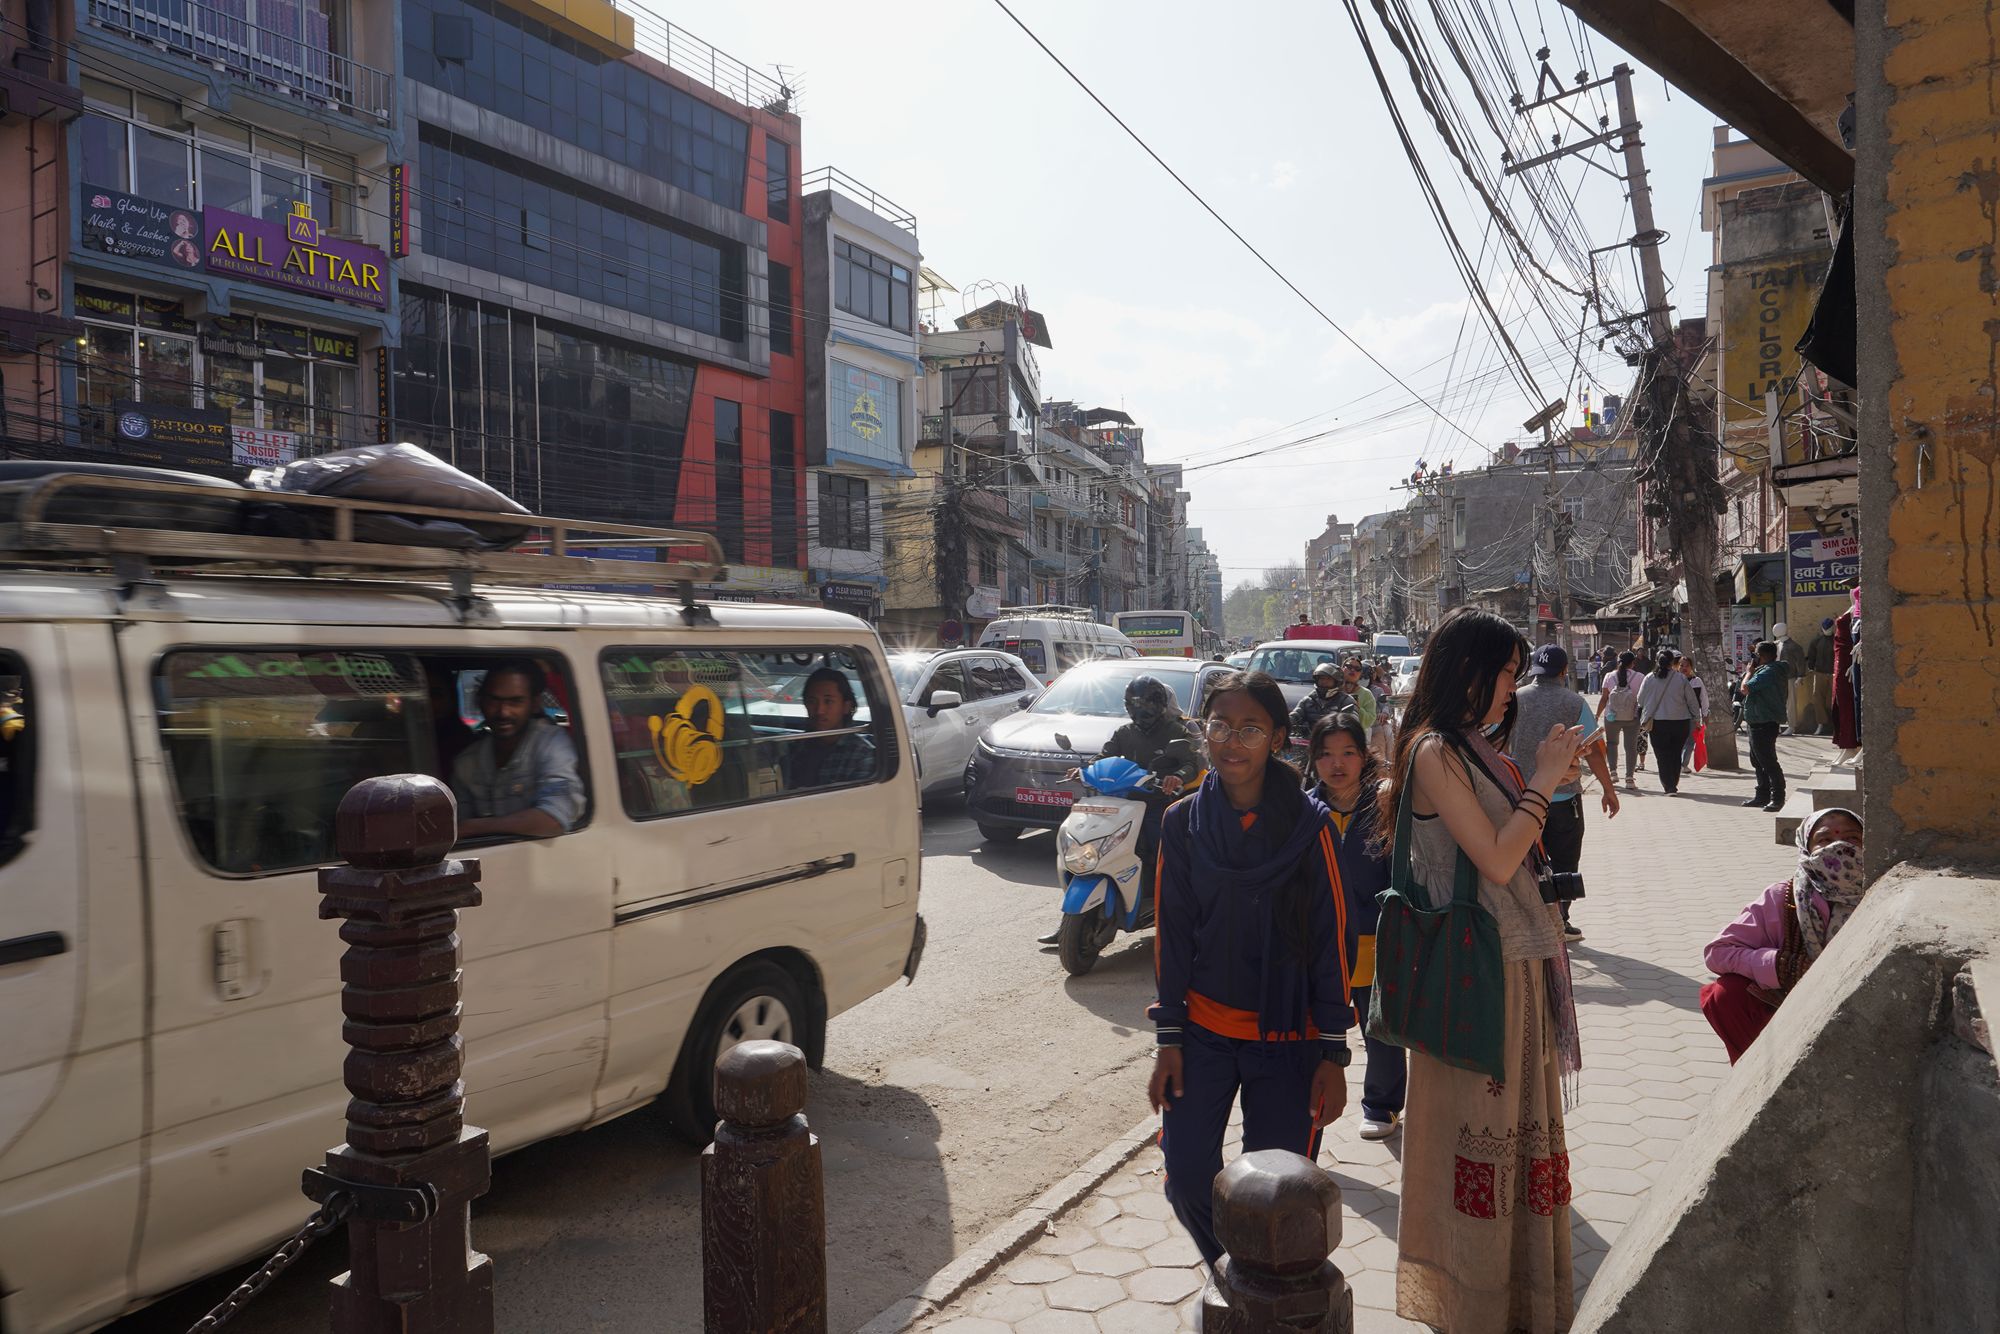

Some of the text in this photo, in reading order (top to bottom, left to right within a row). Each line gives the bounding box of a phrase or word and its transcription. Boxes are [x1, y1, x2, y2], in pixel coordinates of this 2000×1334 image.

[117, 199, 168, 222] Glow Up
[393, 167, 401, 253] PERFUME
[88, 213, 170, 243] Nails & Lashes
[210, 227, 382, 292] ALL ATTAR
[264, 269, 294, 284] ATTAR
[324, 283, 384, 304] FRAGRANCES
[1751, 267, 1793, 290] TAJ
[1759, 290, 1781, 379] COLOR
[313, 335, 355, 359] VAPE
[1748, 377, 1798, 401] LAB
[151, 419, 206, 434] TATTOO
[246, 445, 281, 459] INSIDE
[1822, 536, 1859, 550] SIM CA
[1835, 545, 1858, 557] eSIM
[1793, 564, 1826, 579] हवाई
[835, 586, 849, 595] CLEAR
[850, 587, 863, 596] VISION
[1794, 581, 1817, 593] AIR
[1538, 652, 1549, 664] NY
[1020, 750, 1074, 760] OMODA
